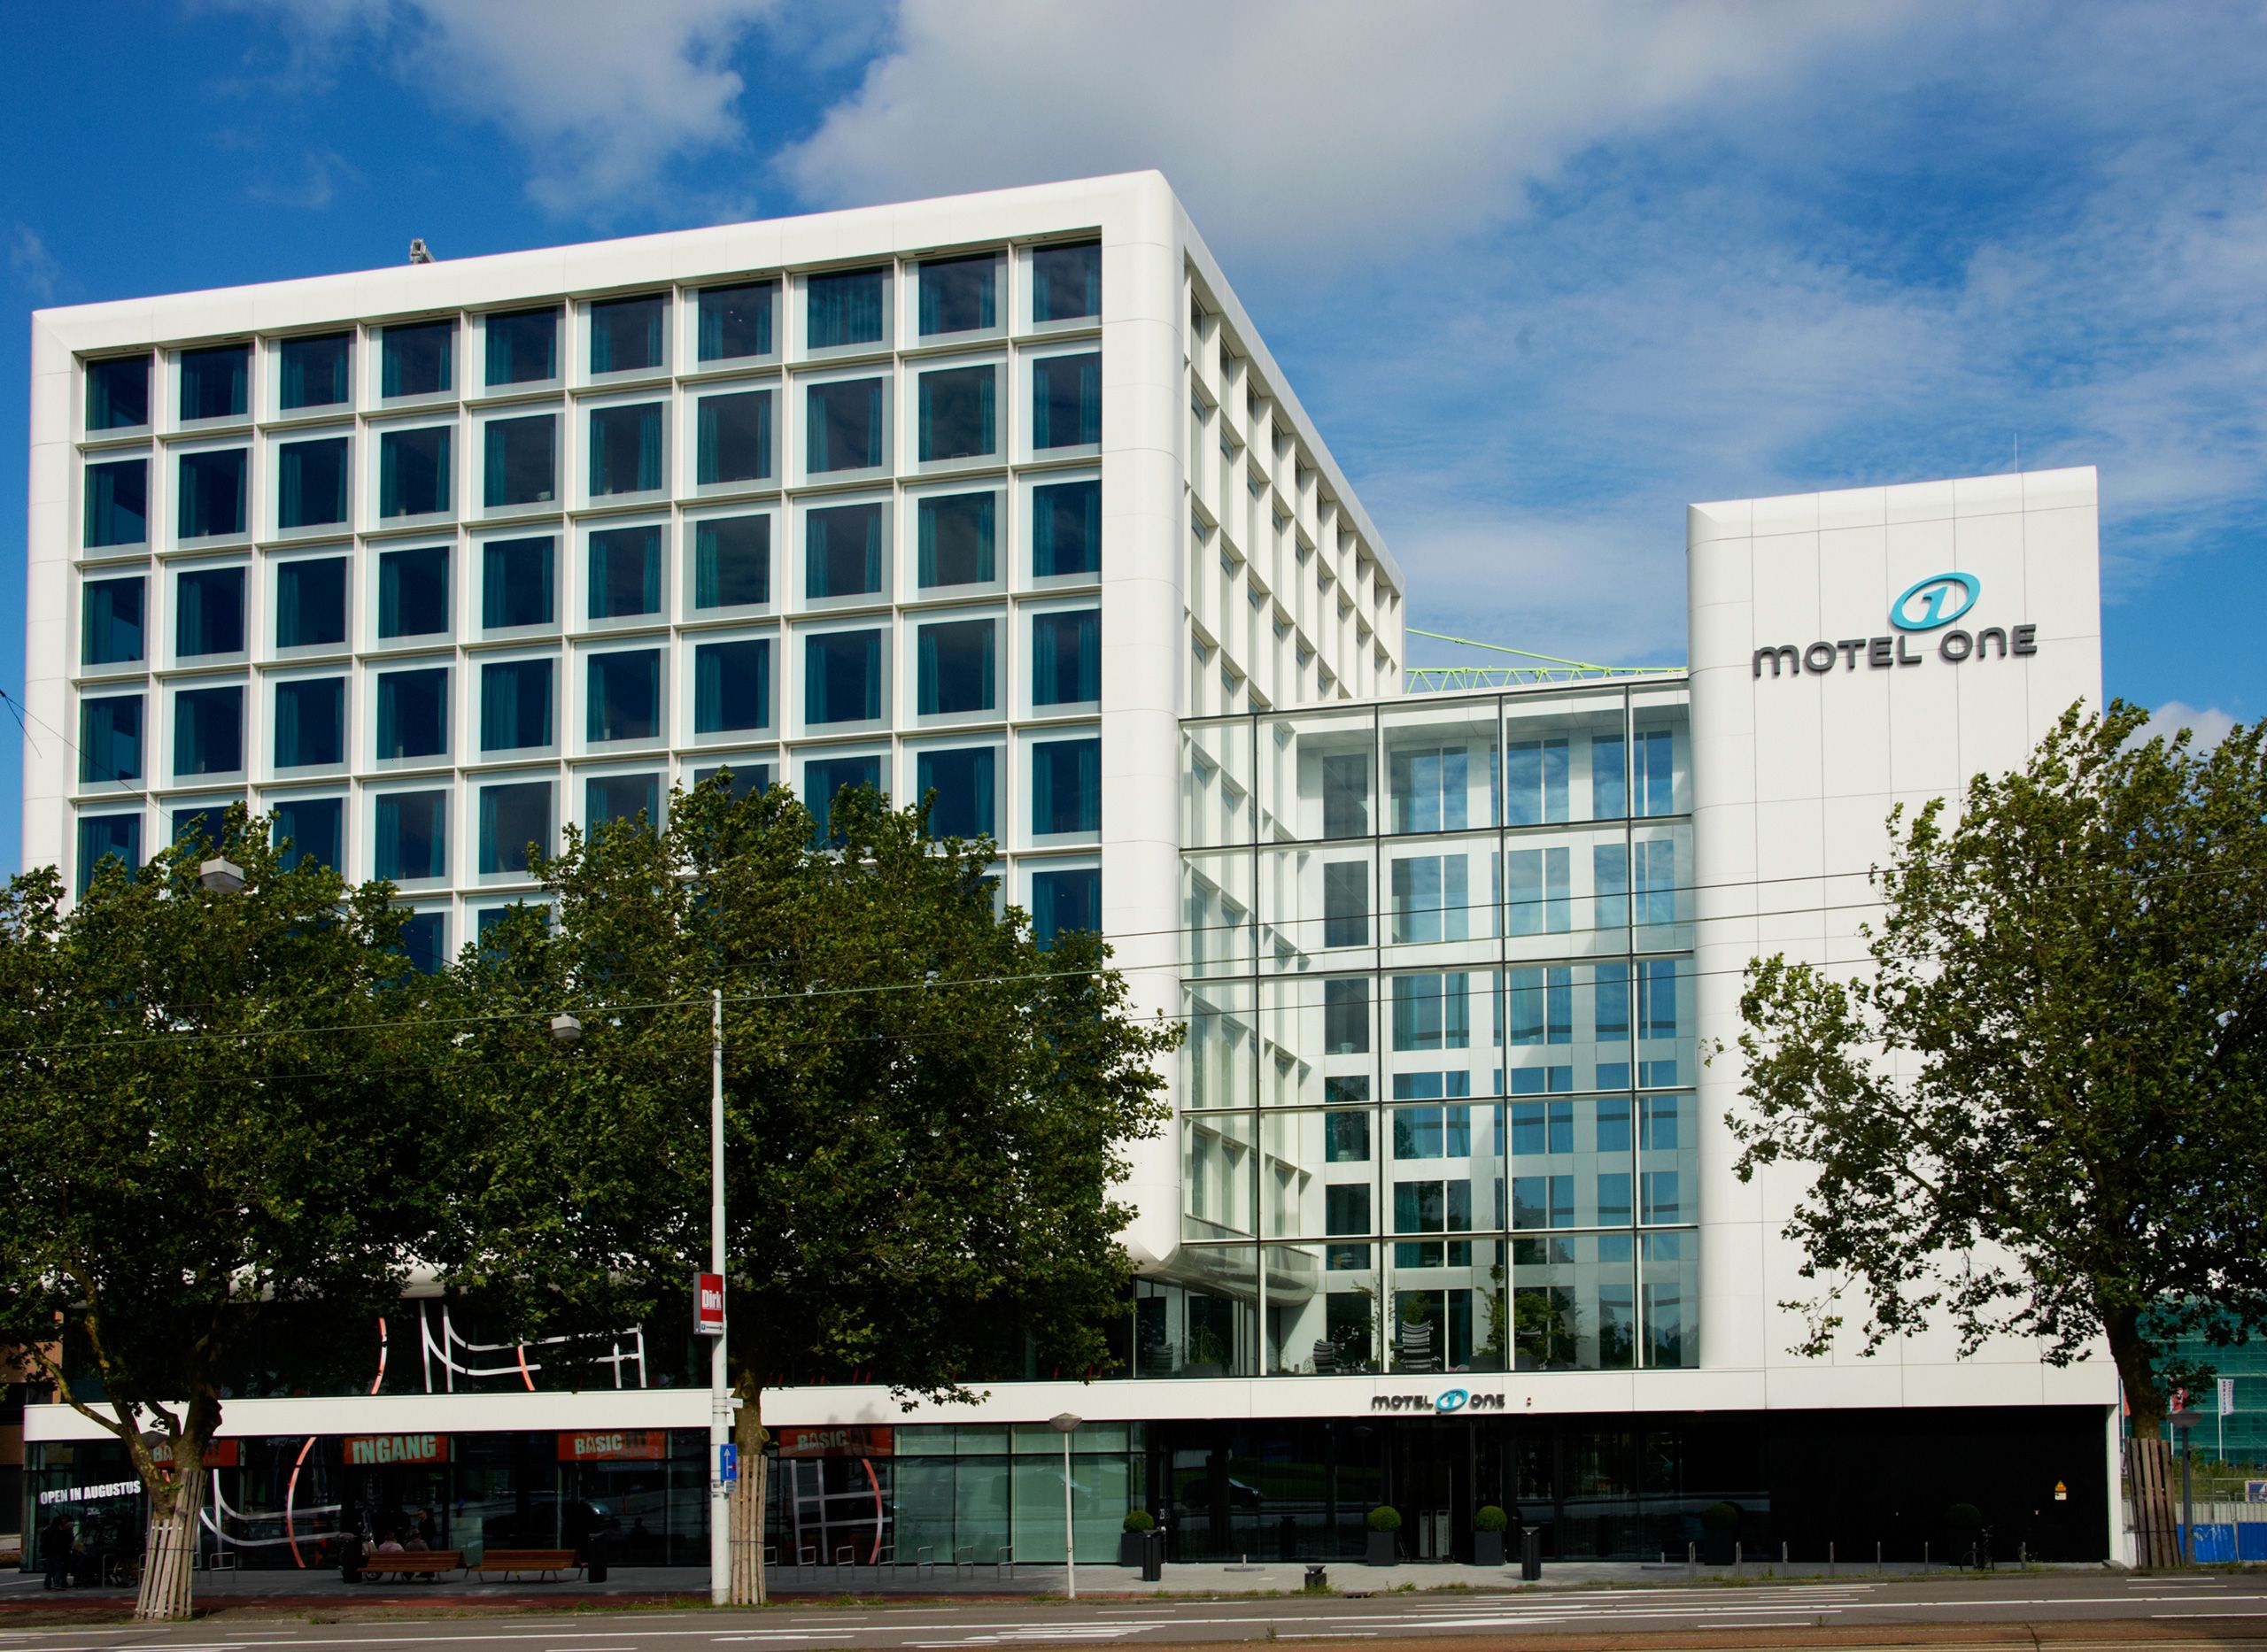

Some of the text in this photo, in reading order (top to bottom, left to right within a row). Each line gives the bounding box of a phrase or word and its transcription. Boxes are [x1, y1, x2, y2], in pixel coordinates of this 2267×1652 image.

[701, 1289, 722, 1310] Dirk
[352, 1434, 437, 1464] INGANG
[574, 1433, 623, 1455] BASIC
[797, 1430, 847, 1451] BASIC
[40, 1480, 142, 1505] OPEN IN AUGUSTUS
